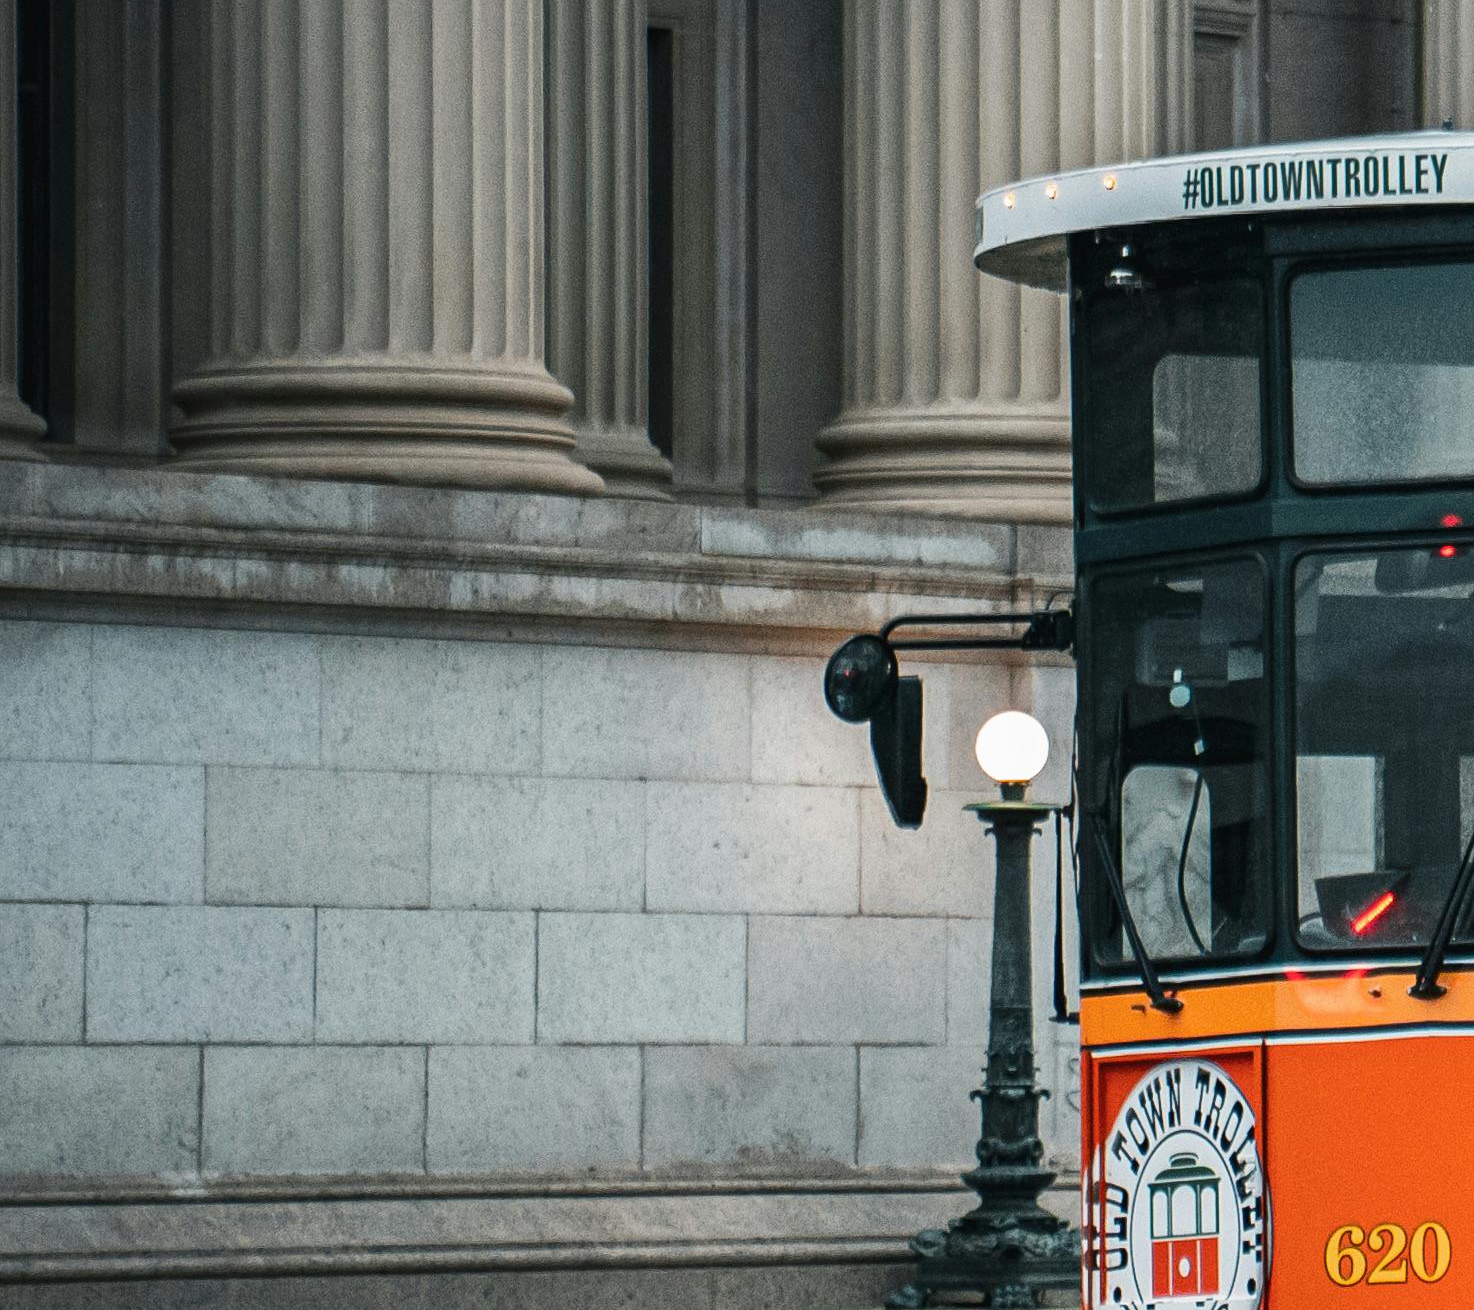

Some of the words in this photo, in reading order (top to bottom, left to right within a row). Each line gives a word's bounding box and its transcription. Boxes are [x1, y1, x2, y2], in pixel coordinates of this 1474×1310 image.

[1183, 153, 1448, 210] #OLDTOWNTROLLEY
[1111, 1067, 1182, 1176] TOWN
[1324, 1220, 1453, 1287] 620
